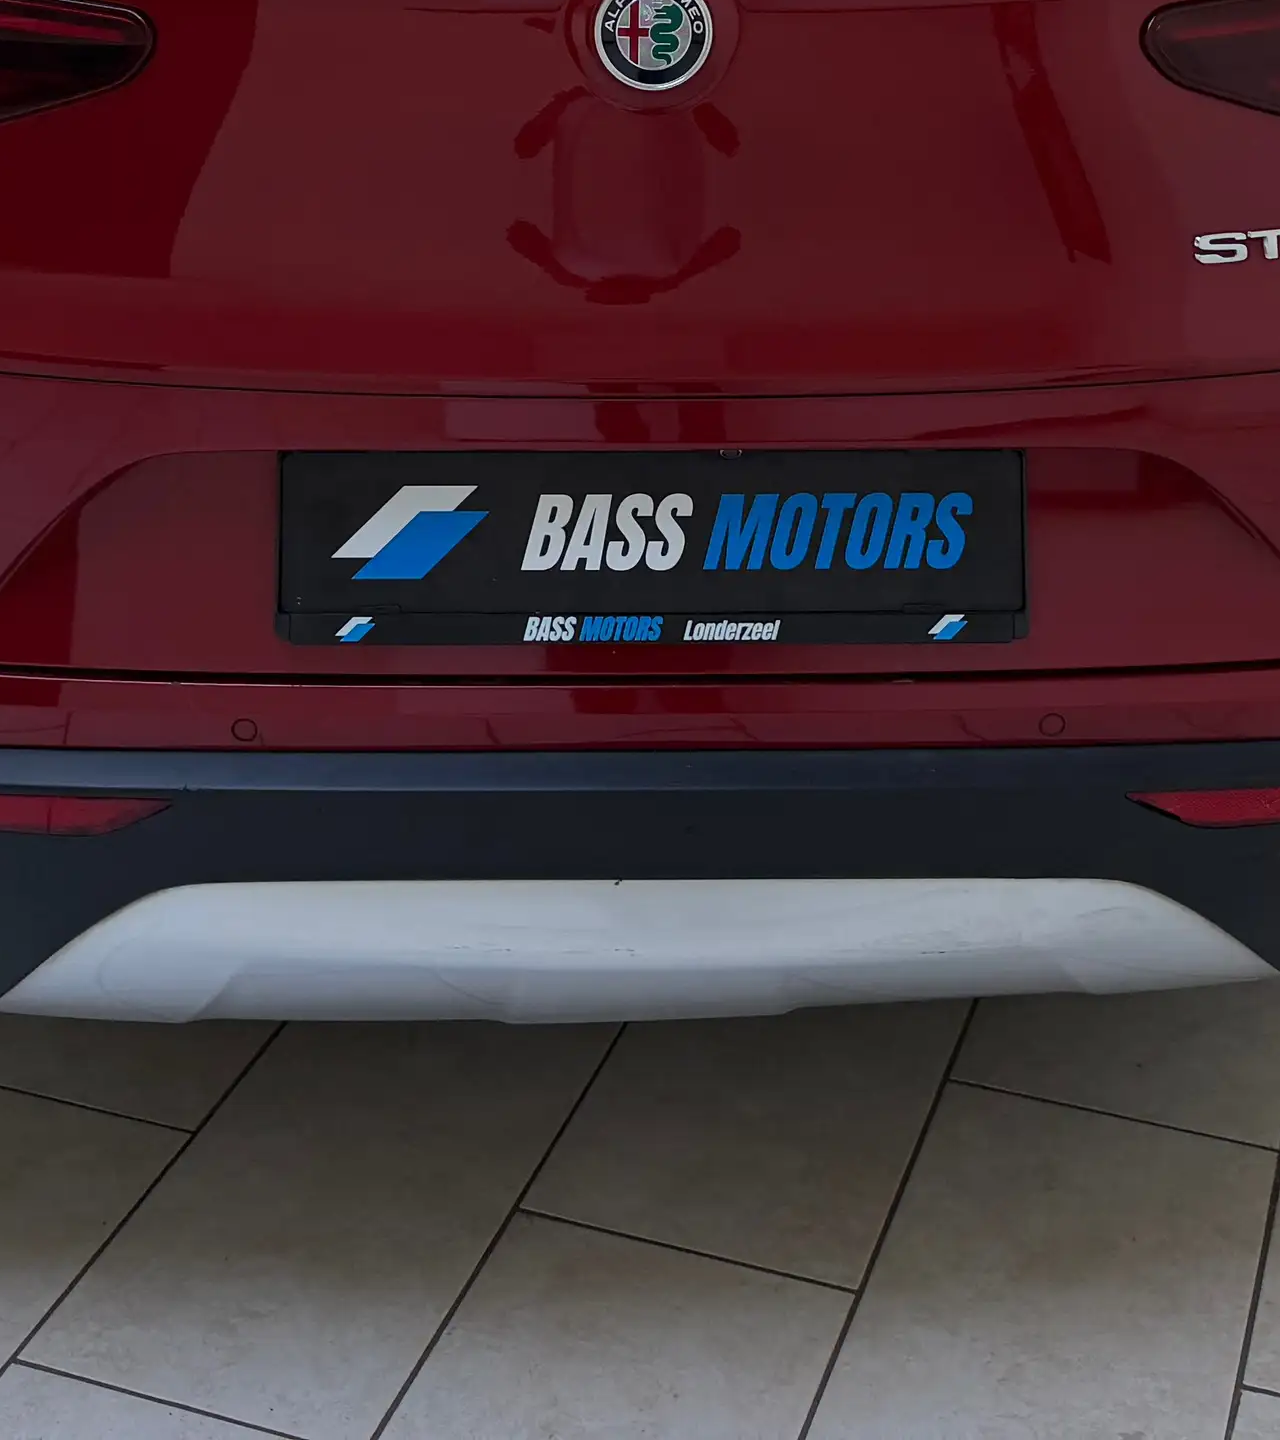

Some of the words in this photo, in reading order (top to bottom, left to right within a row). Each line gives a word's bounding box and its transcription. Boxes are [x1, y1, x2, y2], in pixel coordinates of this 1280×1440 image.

[520, 492, 694, 572] BASS
[702, 492, 974, 571] MOTORS
[523, 616, 577, 642] BASS
[579, 616, 663, 642] MOTORS
[683, 619, 781, 641] Londerzeel
